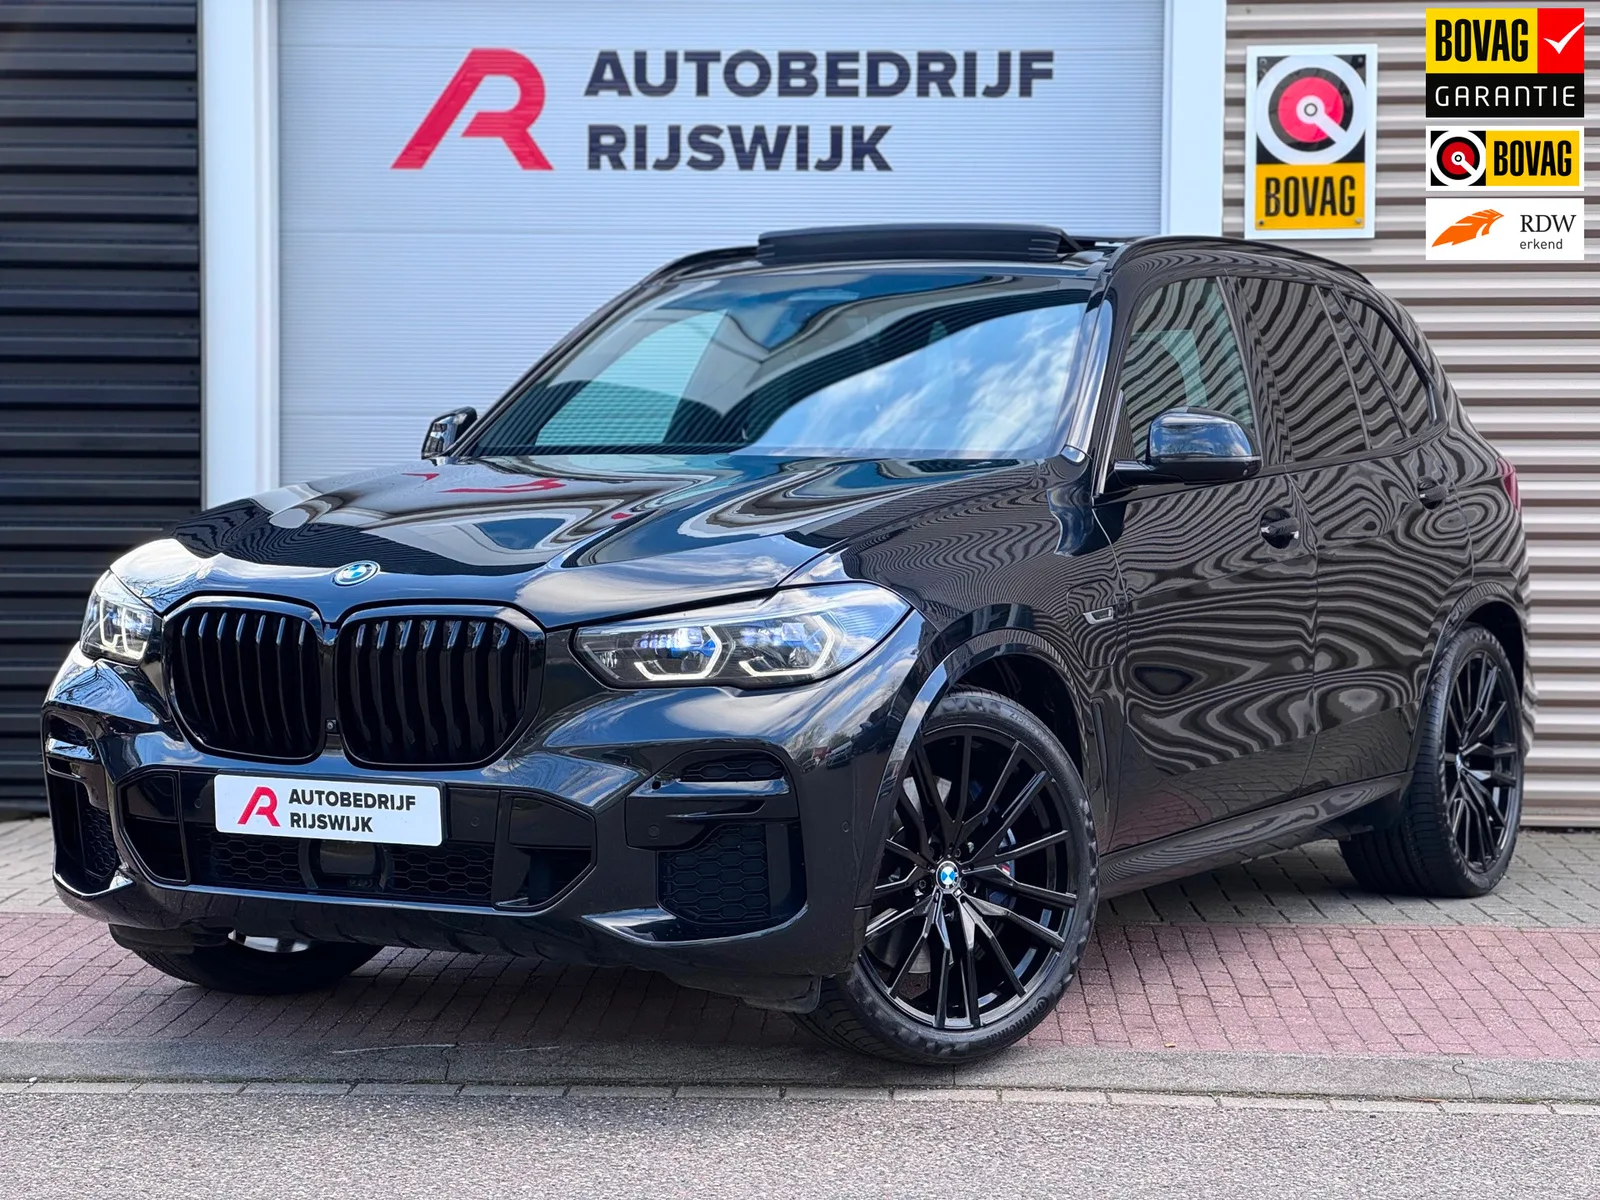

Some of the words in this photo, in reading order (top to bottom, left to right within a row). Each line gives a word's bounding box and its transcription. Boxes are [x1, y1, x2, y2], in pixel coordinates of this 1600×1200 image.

[585, 50, 1054, 98] AUTOBEDRIJF
[588, 125, 893, 172] RIJSWIJK
[1264, 175, 1356, 217] BOVAG
[288, 788, 416, 811] AUTOBEDRIJF
[289, 812, 374, 833] RIJSWIJK
